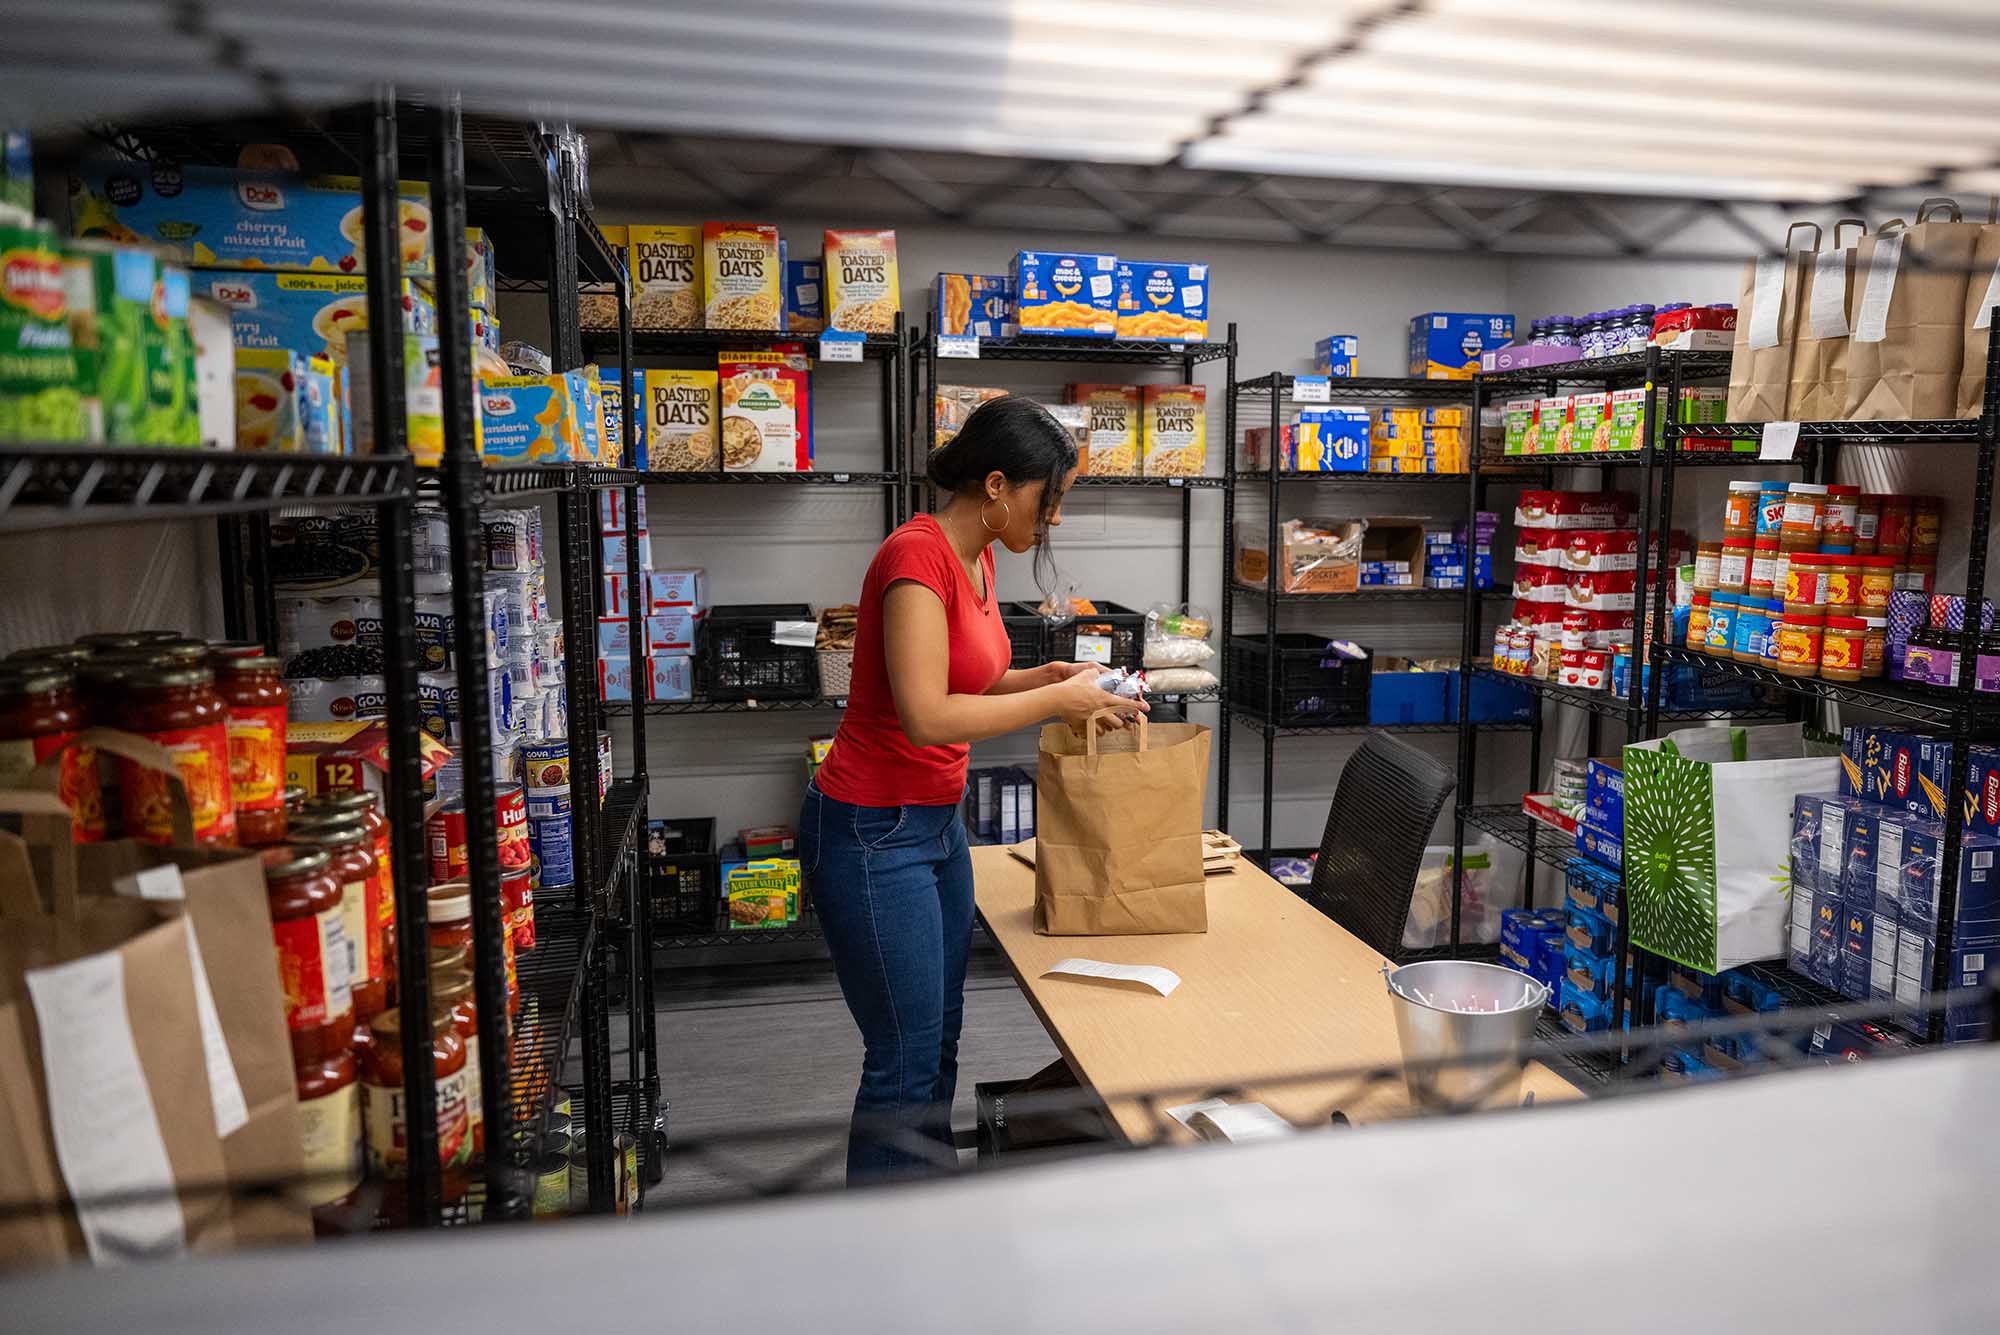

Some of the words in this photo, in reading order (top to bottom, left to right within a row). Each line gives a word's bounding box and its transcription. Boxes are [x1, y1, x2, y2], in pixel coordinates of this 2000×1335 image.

[245, 186, 278, 203] Dole
[236, 220, 288, 237] cherry
[224, 234, 270, 246] mixed
[273, 235, 306, 248] fruit
[636, 242, 695, 260] TOASTED
[717, 247, 765, 260] TOASTED
[840, 255, 885, 267] TOASTED
[638, 259, 694, 283] OATS
[719, 260, 764, 277] OATS
[842, 267, 885, 284] OATS
[335, 279, 365, 292] juice
[218, 288, 251, 302] Dole
[1489, 318, 1504, 330] 18
[247, 335, 279, 346] fruit
[719, 353, 754, 361] GIANT
[756, 353, 781, 362] SIZE
[653, 387, 711, 402] TOASTED
[487, 398, 512, 412] Dole
[656, 403, 710, 426] OATS
[1156, 407, 1195, 418] TOASTED
[484, 423, 529, 433] andarin
[1157, 417, 1194, 432] OATS
[325, 764, 355, 785] 12
[1897, 752, 1908, 793] Barilla
[1986, 775, 2000, 818] Barilla
[731, 880, 760, 892] NATURE
[760, 879, 785, 889] VALLEY
